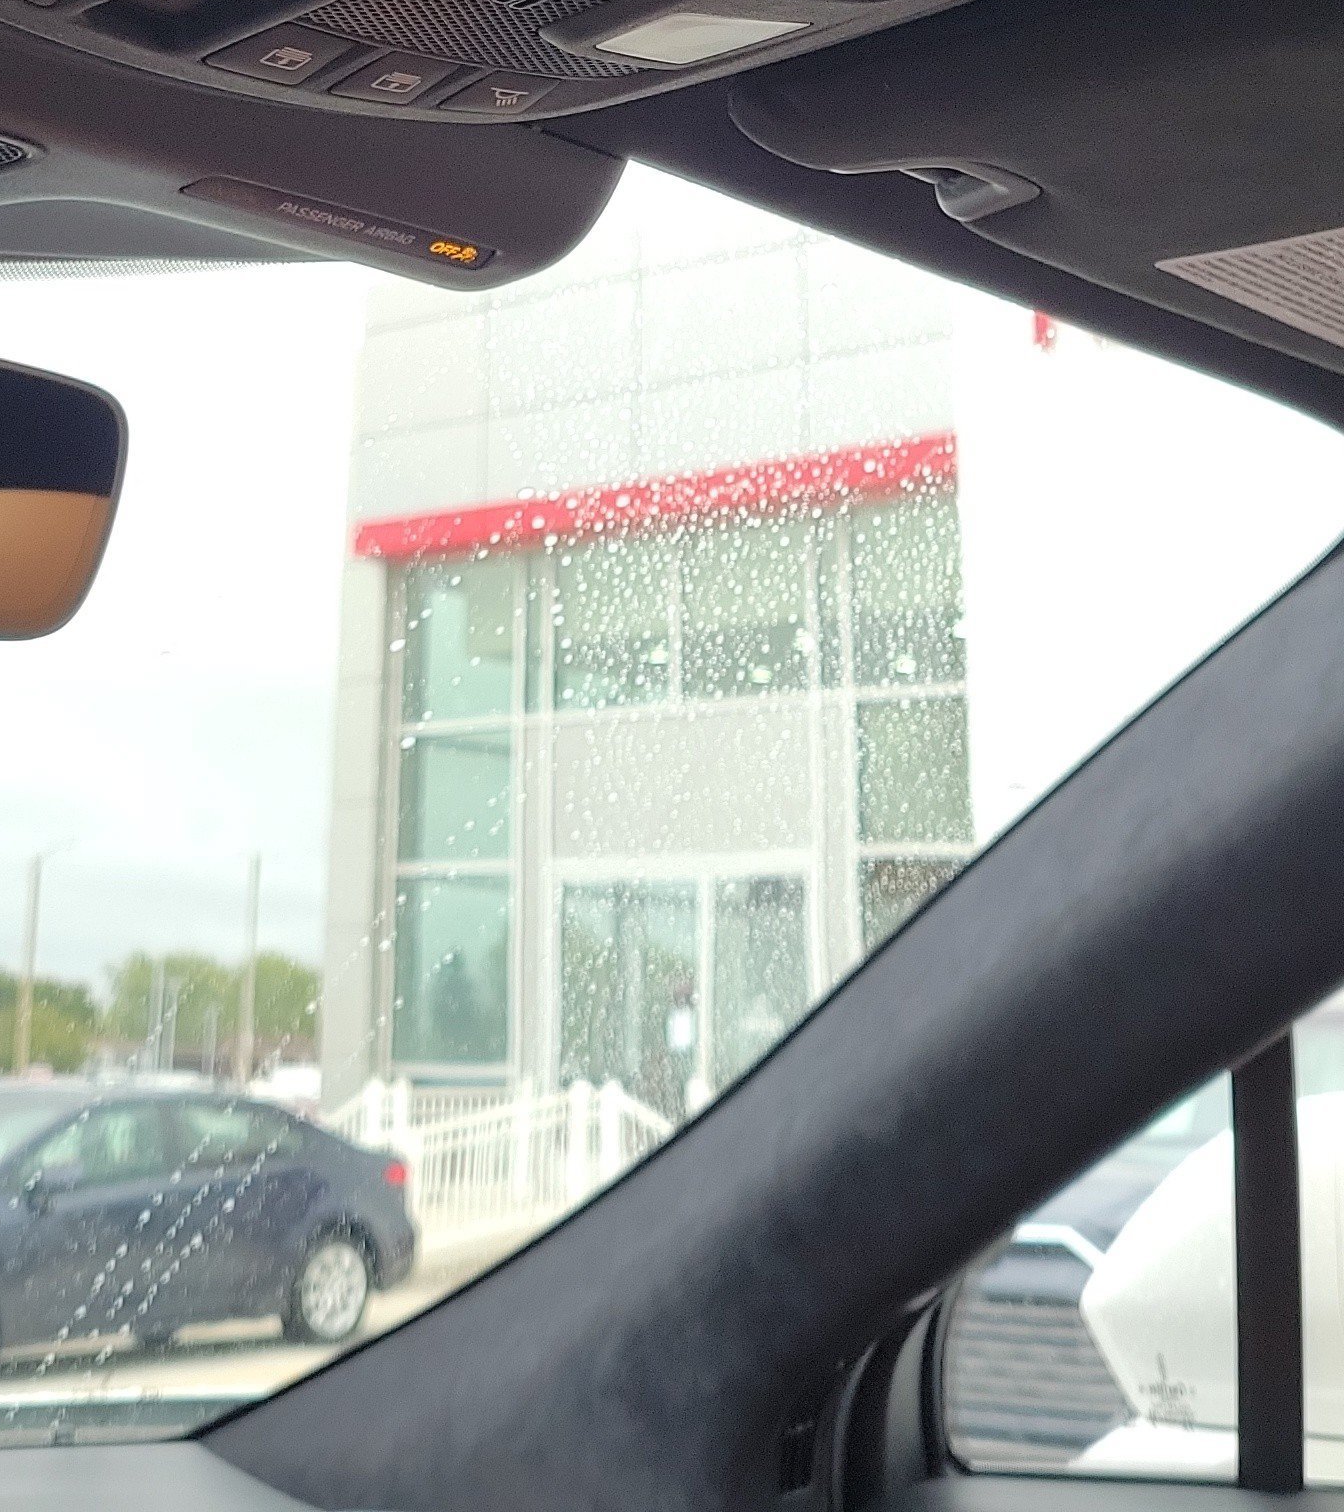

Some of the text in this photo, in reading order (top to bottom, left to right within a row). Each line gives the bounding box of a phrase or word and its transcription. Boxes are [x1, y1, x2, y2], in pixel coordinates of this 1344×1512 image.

[277, 201, 459, 257] PASSENGER AIRBAG OFF
